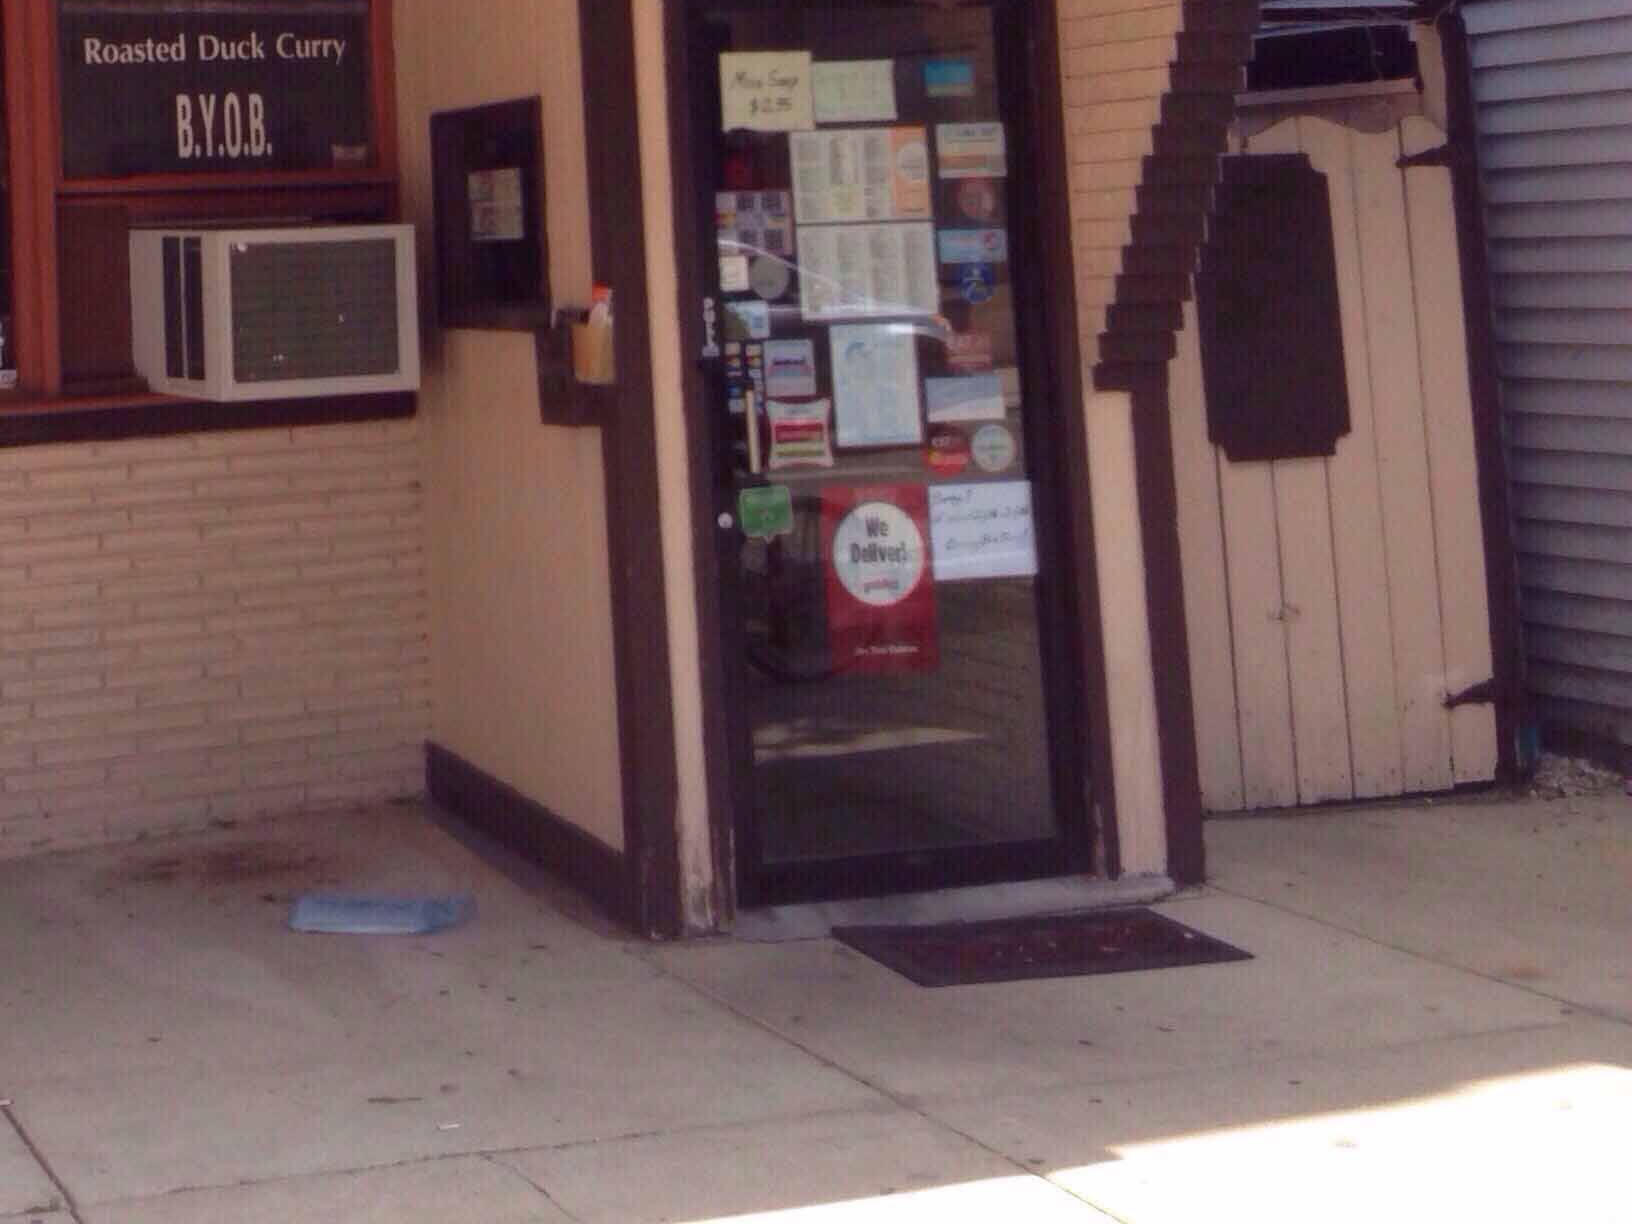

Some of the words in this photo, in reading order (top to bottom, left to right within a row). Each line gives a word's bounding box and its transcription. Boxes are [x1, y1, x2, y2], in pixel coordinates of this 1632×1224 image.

[83, 34, 186, 65] Roasted
[198, 32, 265, 62] Duck
[275, 32, 346, 65] Curry
[176, 91, 274, 159] B.Y.O.B.
[865, 513, 890, 537] We
